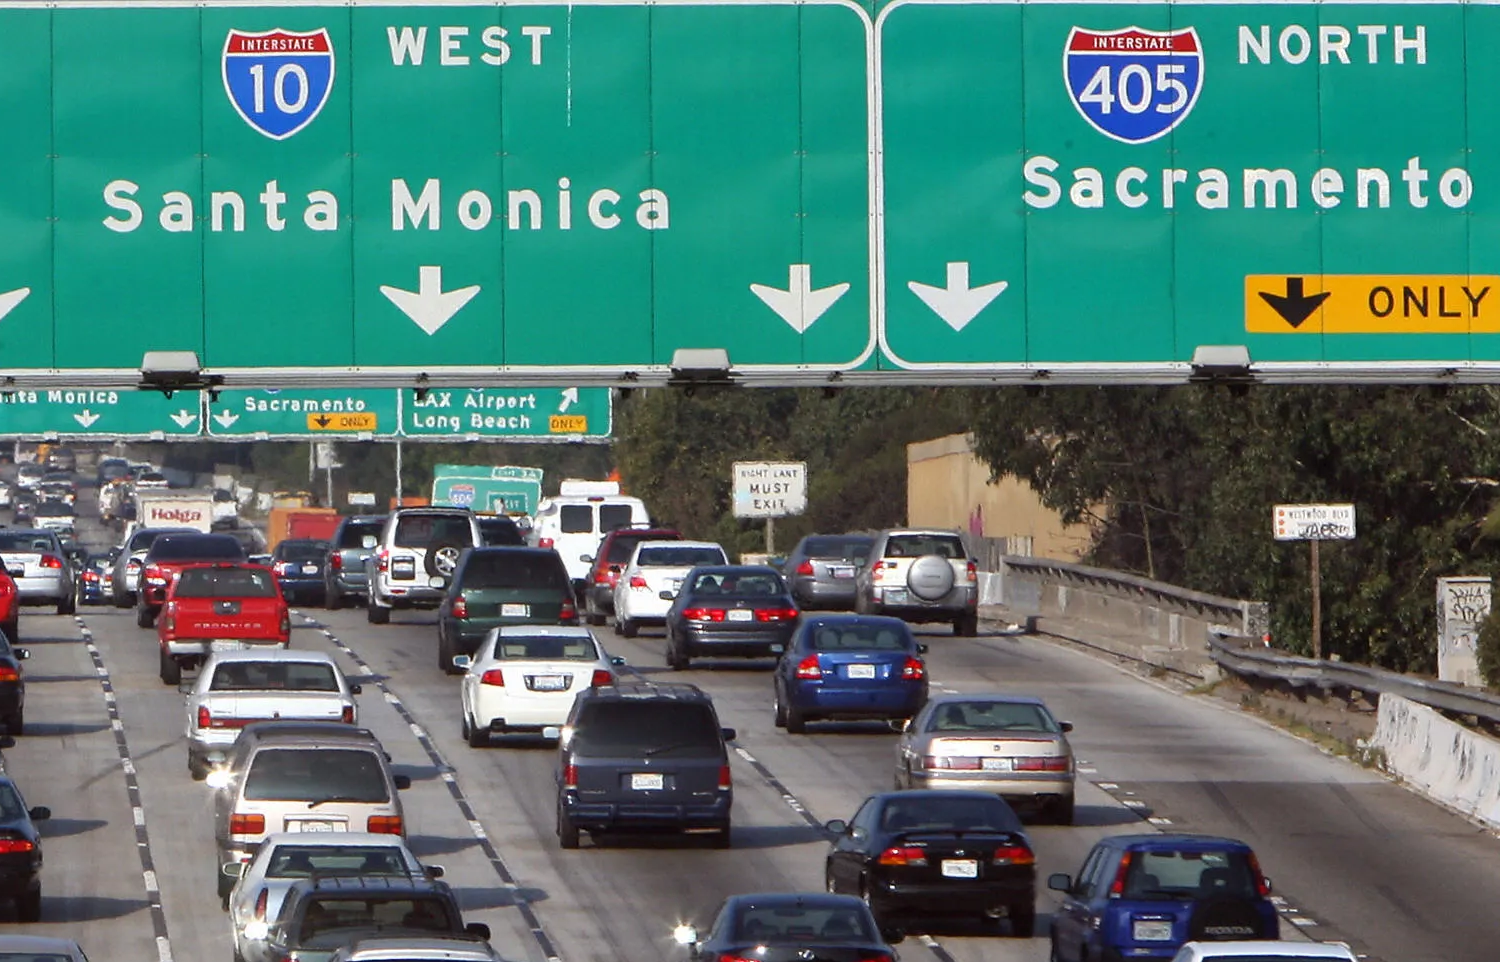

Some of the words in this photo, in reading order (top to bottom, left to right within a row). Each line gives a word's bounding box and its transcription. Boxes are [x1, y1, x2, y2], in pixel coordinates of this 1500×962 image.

[240, 37, 315, 51] INTERSTATE
[387, 25, 552, 66] WEST
[1092, 35, 1174, 50] INTERSTATE
[1238, 25, 1428, 65] NORTH
[249, 63, 310, 115] 10
[1078, 63, 1189, 115] 405
[1022, 155, 1474, 209] Sacramento
[102, 179, 339, 233] Santa
[392, 177, 670, 231] Monica
[1368, 285, 1491, 319] ONLY
[48, 390, 119, 404] Monica
[245, 396, 366, 412] Sacramento
[413, 393, 451, 408] LAX
[464, 392, 536, 411] Airport
[340, 417, 371, 428] ONLY
[413, 413, 461, 431] Long
[471, 413, 531, 430] Beach
[551, 417, 584, 429] ONLY
[741, 469, 768, 478] RIGHT
[773, 469, 798, 478] LANE
[750, 483, 790, 494] MUST
[754, 499, 785, 510] EXIT
[151, 507, 202, 523] Holga
[1289, 510, 1327, 520] WESTWOOD
[1332, 511, 1349, 519] BLVD
